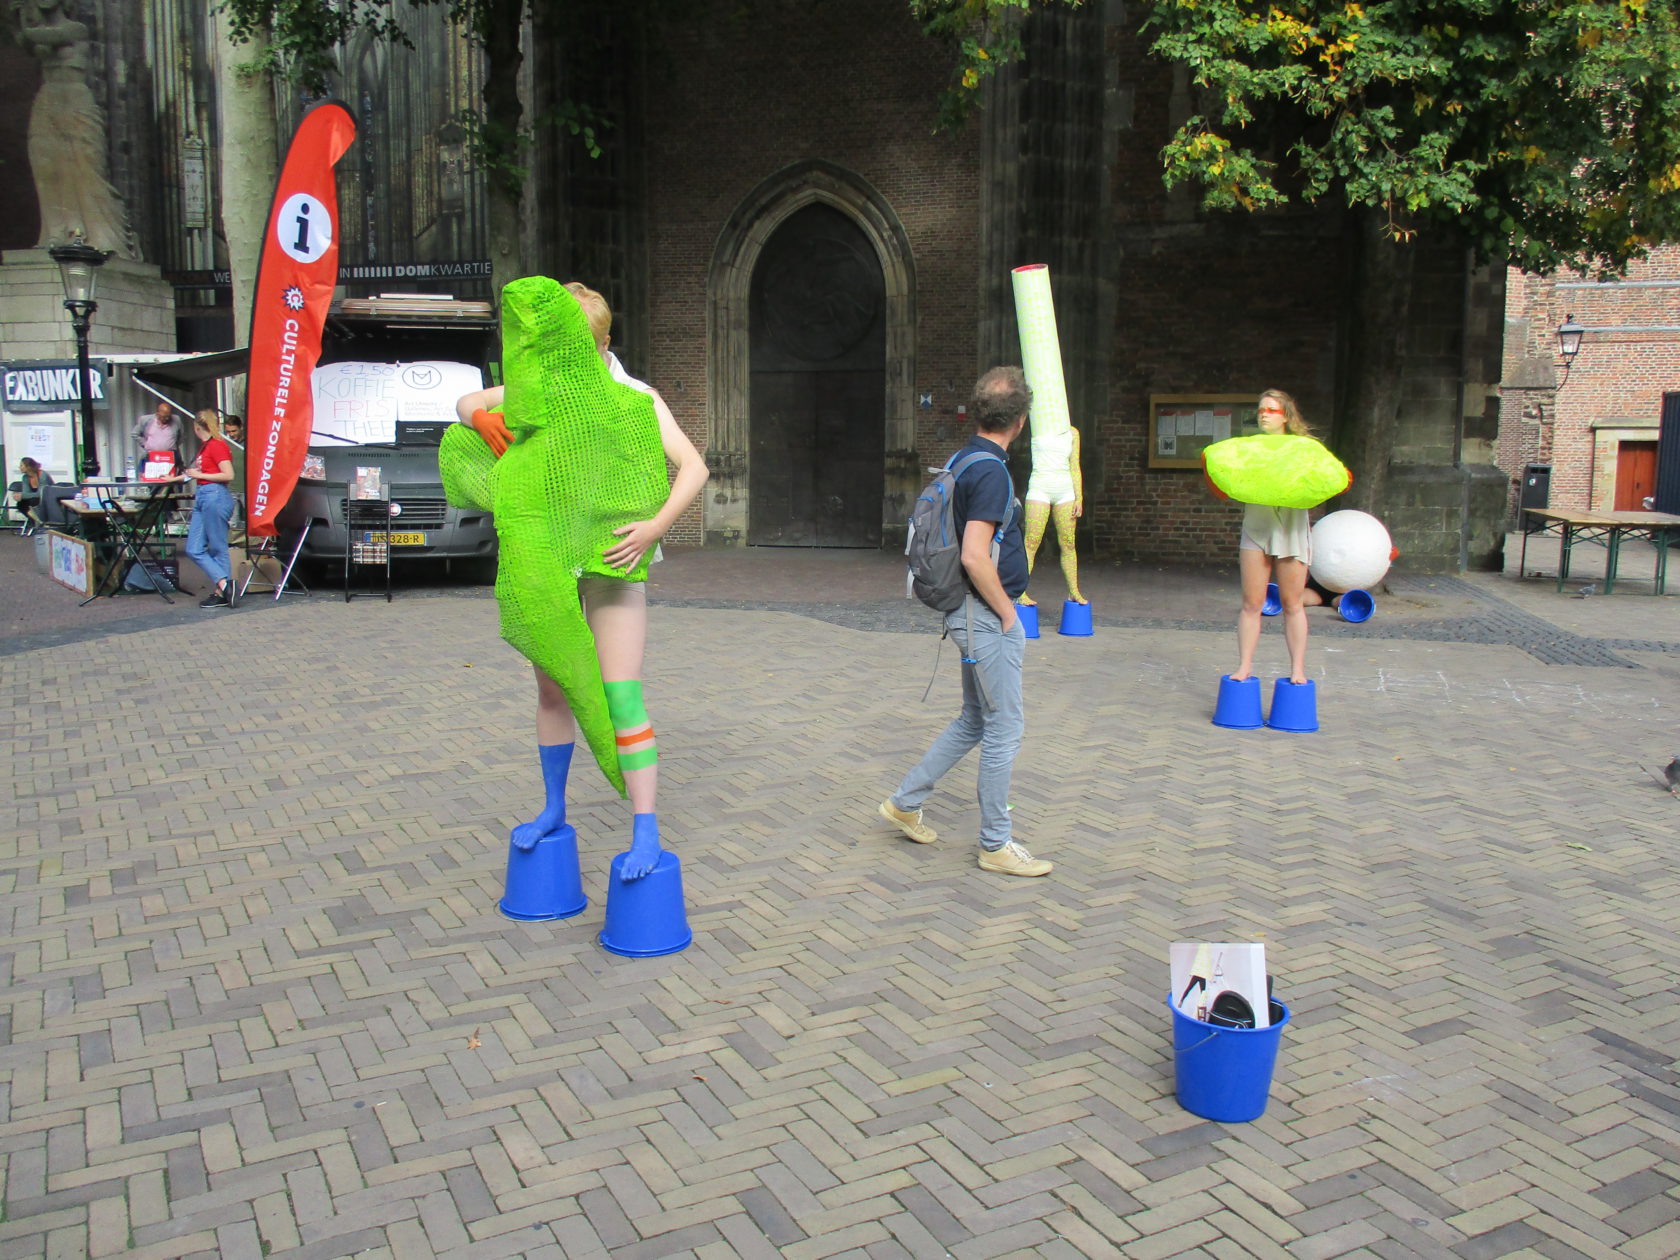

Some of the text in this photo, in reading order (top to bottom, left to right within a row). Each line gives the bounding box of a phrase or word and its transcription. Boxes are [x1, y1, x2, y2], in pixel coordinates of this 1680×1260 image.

[294, 203, 310, 254] i
[213, 271, 230, 283] WE
[340, 267, 350, 278] IN
[395, 262, 492, 277] DOMKWARTIE
[318, 377, 396, 399] KOFFIE
[254, 319, 299, 517] CULTURELE ZONDAGEN
[333, 420, 395, 437] THEE
